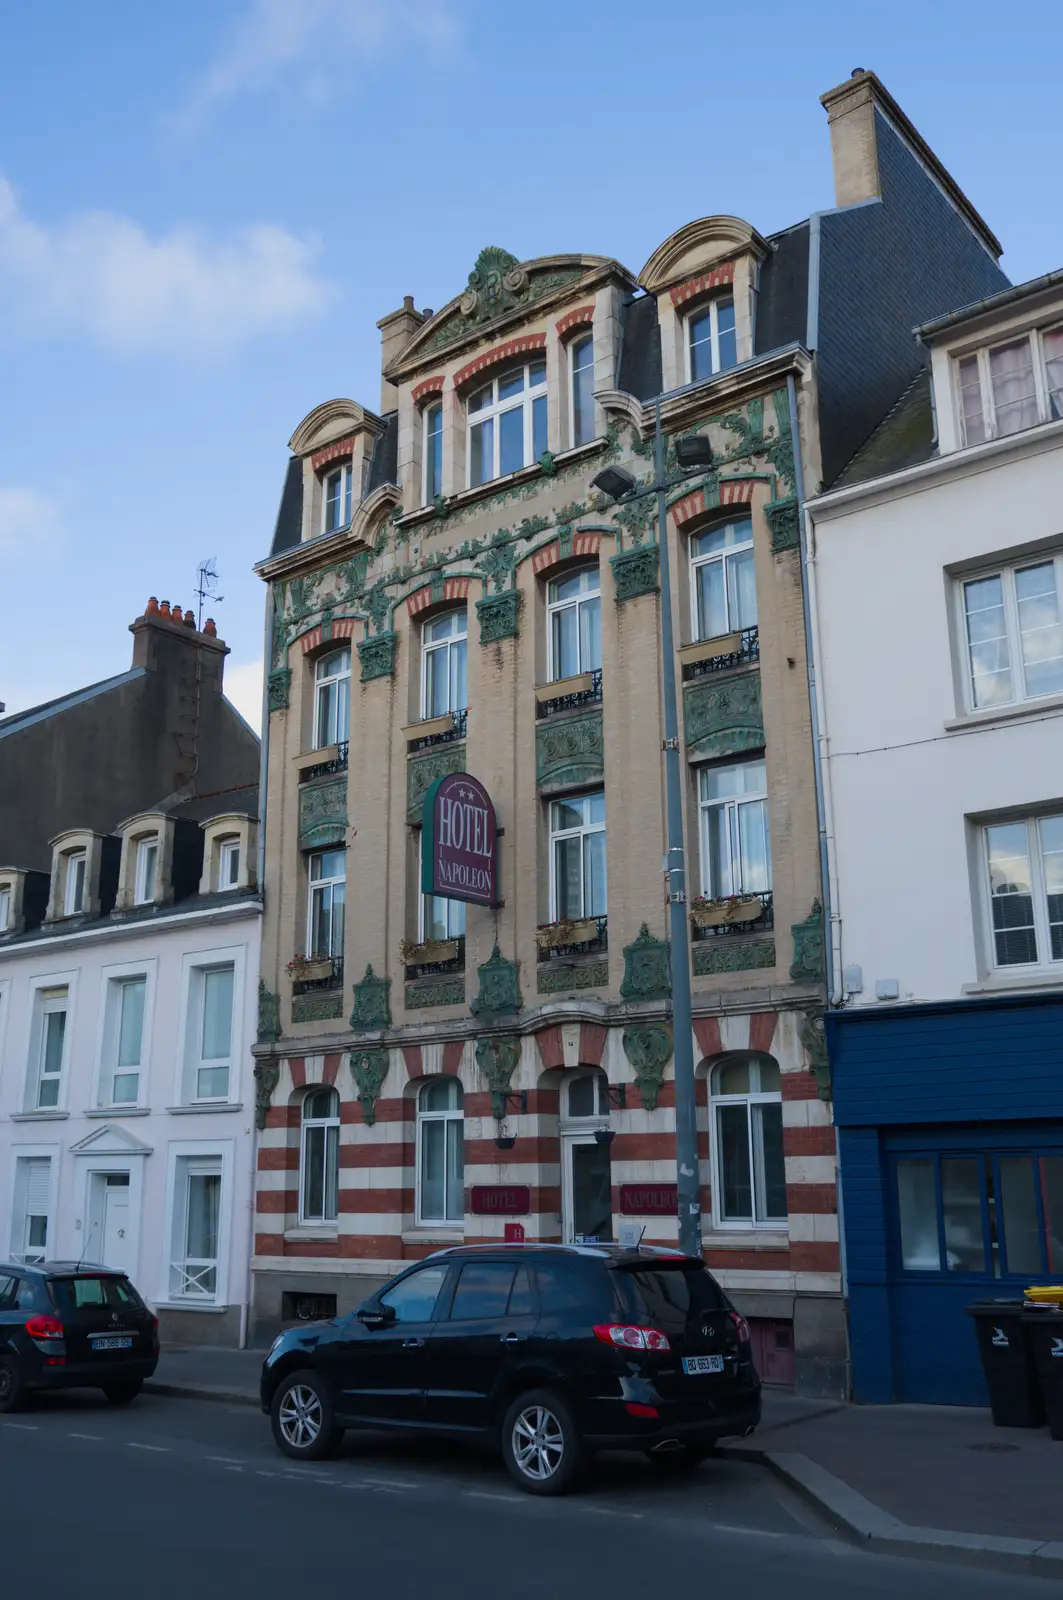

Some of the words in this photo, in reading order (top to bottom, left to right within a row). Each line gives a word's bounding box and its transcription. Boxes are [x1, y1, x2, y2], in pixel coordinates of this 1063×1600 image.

[438, 796, 492, 858] HOTEL
[438, 859, 492, 891] NAPOLEON
[481, 1190, 518, 1210] HOTEL
[513, 1228, 522, 1240] H
